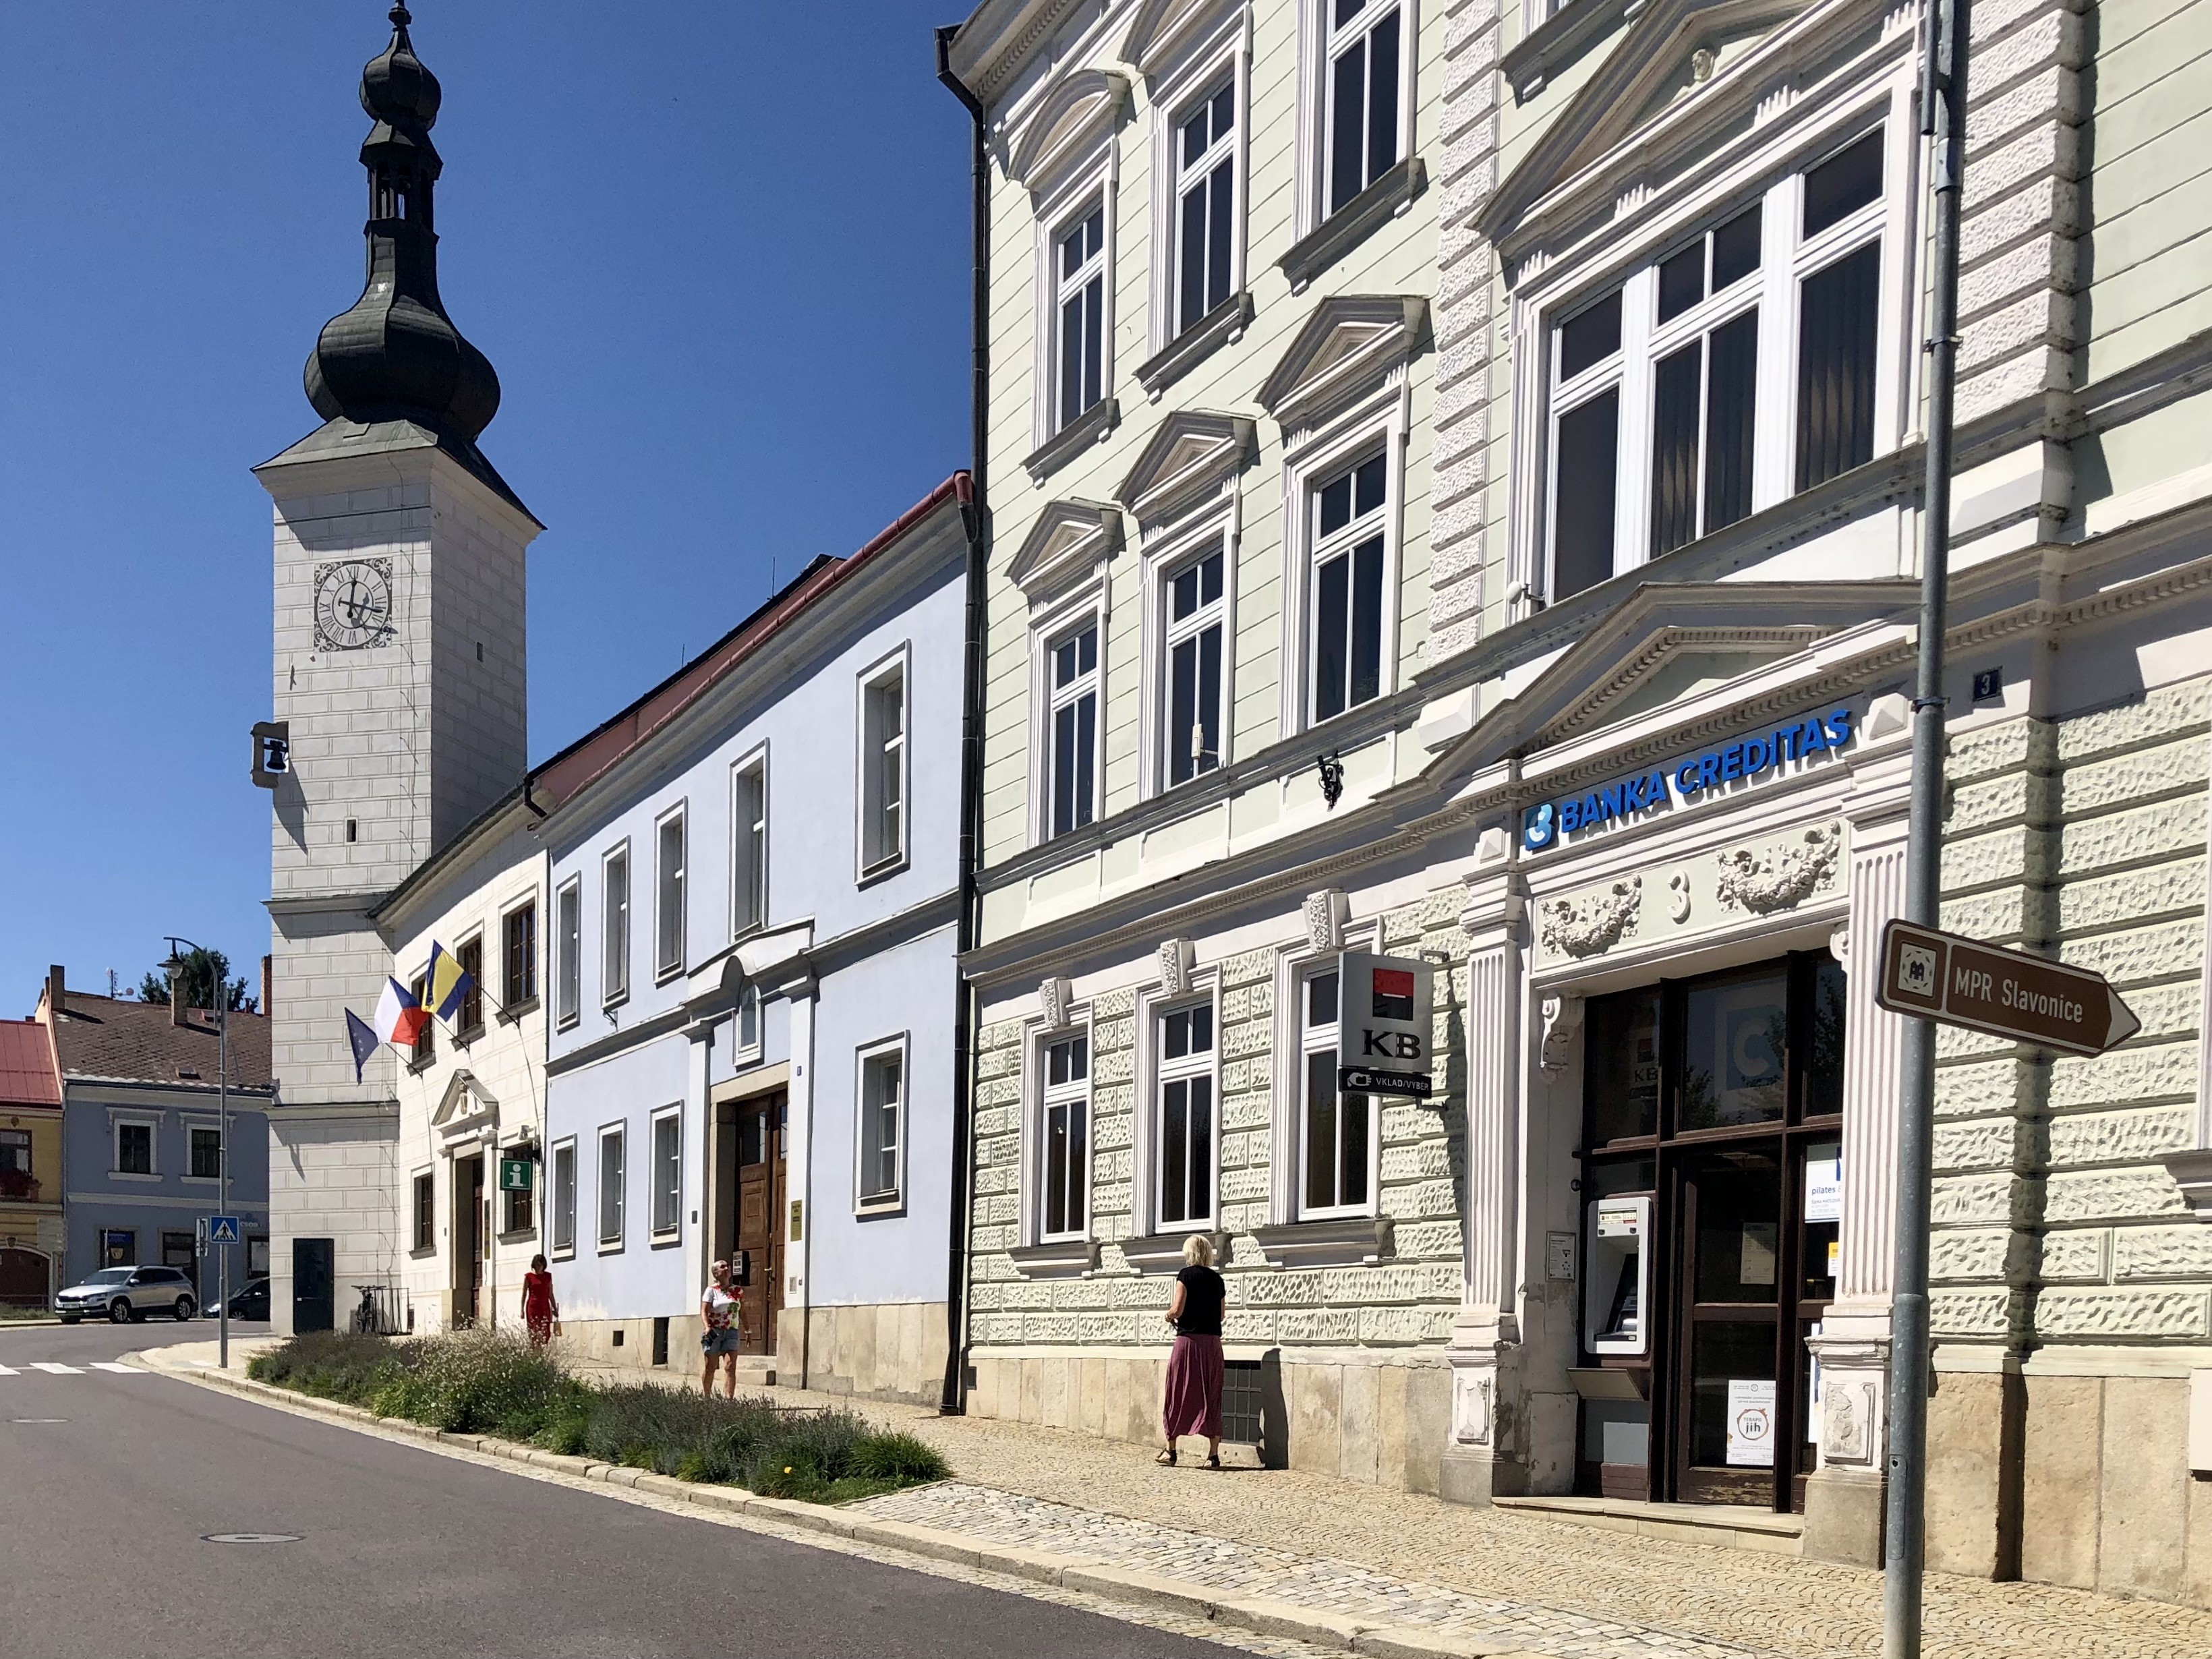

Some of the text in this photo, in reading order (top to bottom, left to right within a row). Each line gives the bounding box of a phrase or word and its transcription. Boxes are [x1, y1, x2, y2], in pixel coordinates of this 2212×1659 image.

[1981, 674, 1991, 695] 3
[1562, 709, 1853, 833] BANKA CREDITAS
[1667, 870, 1691, 924] 3
[1955, 966, 2083, 1023] MPR Slavonice
[1362, 1030, 1421, 1059] KB
[1811, 1186, 1836, 1196] pilates
[1745, 1422, 1761, 1434] jih
